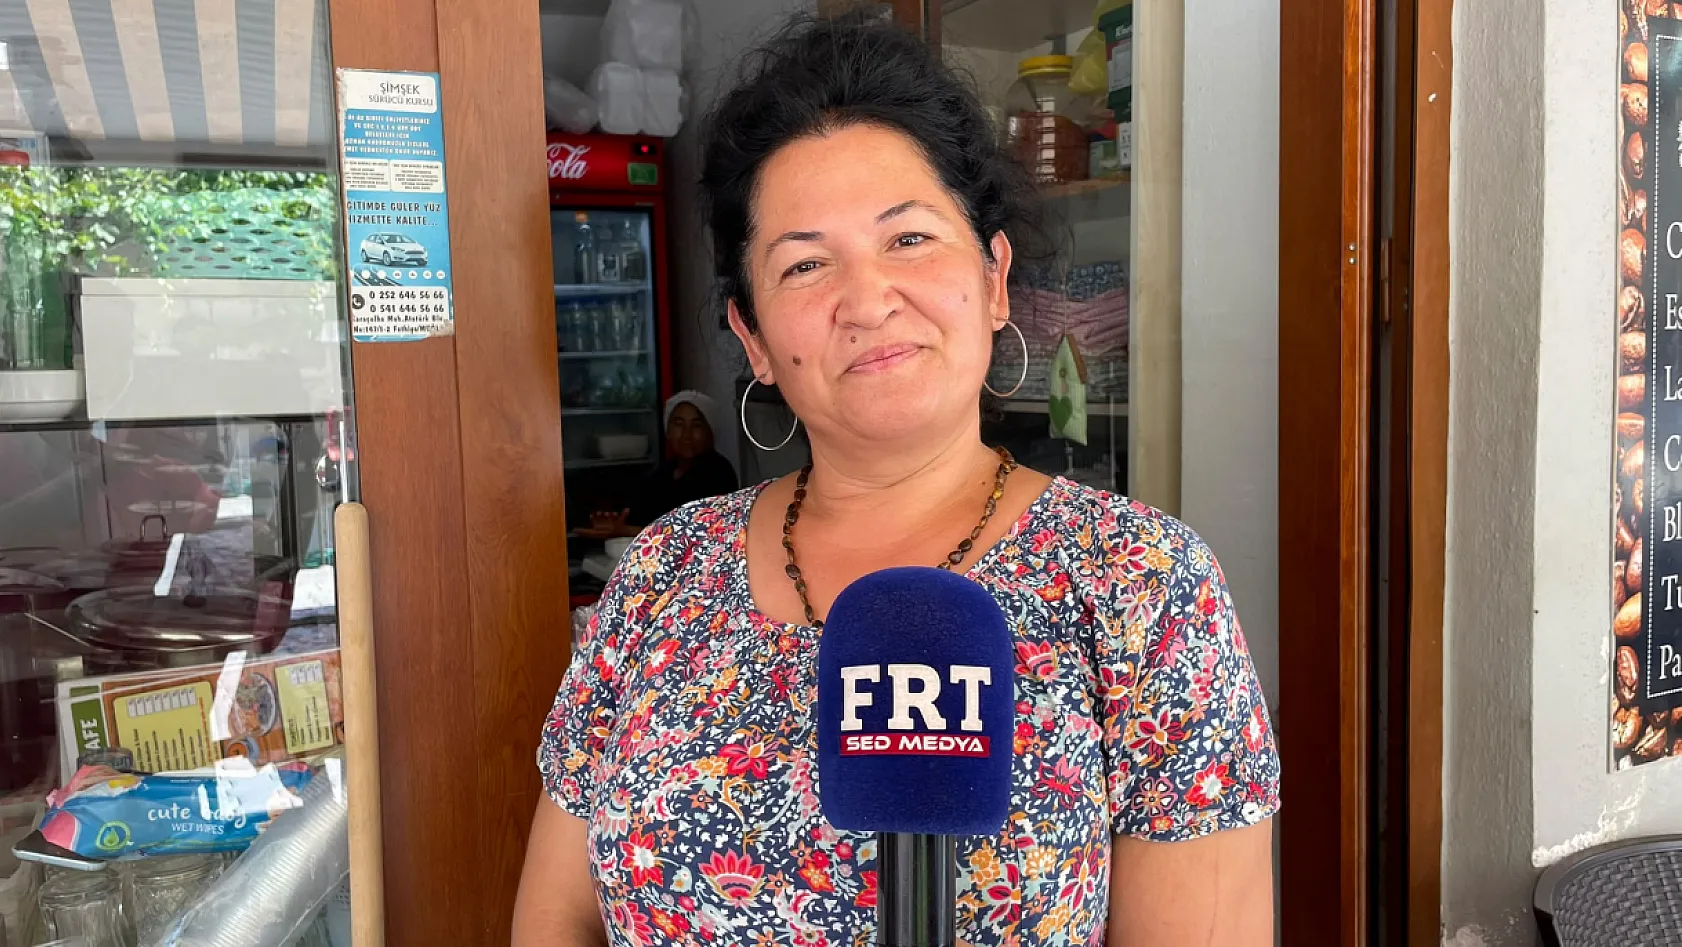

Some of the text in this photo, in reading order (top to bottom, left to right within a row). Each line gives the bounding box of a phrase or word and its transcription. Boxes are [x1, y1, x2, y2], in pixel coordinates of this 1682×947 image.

[380, 80, 420, 96] ŞİMŞEK
[369, 94, 433, 106] SÜRÜCÜ KURSU
[369, 290, 445, 299] 0 252 646 56 66
[370, 304, 445, 313] 0 541 646 56 66
[840, 663, 992, 731] FRT
[846, 735, 984, 752] SED MEDYA
[147, 803, 192, 821] cute
[171, 823, 224, 836] WET WIPES
